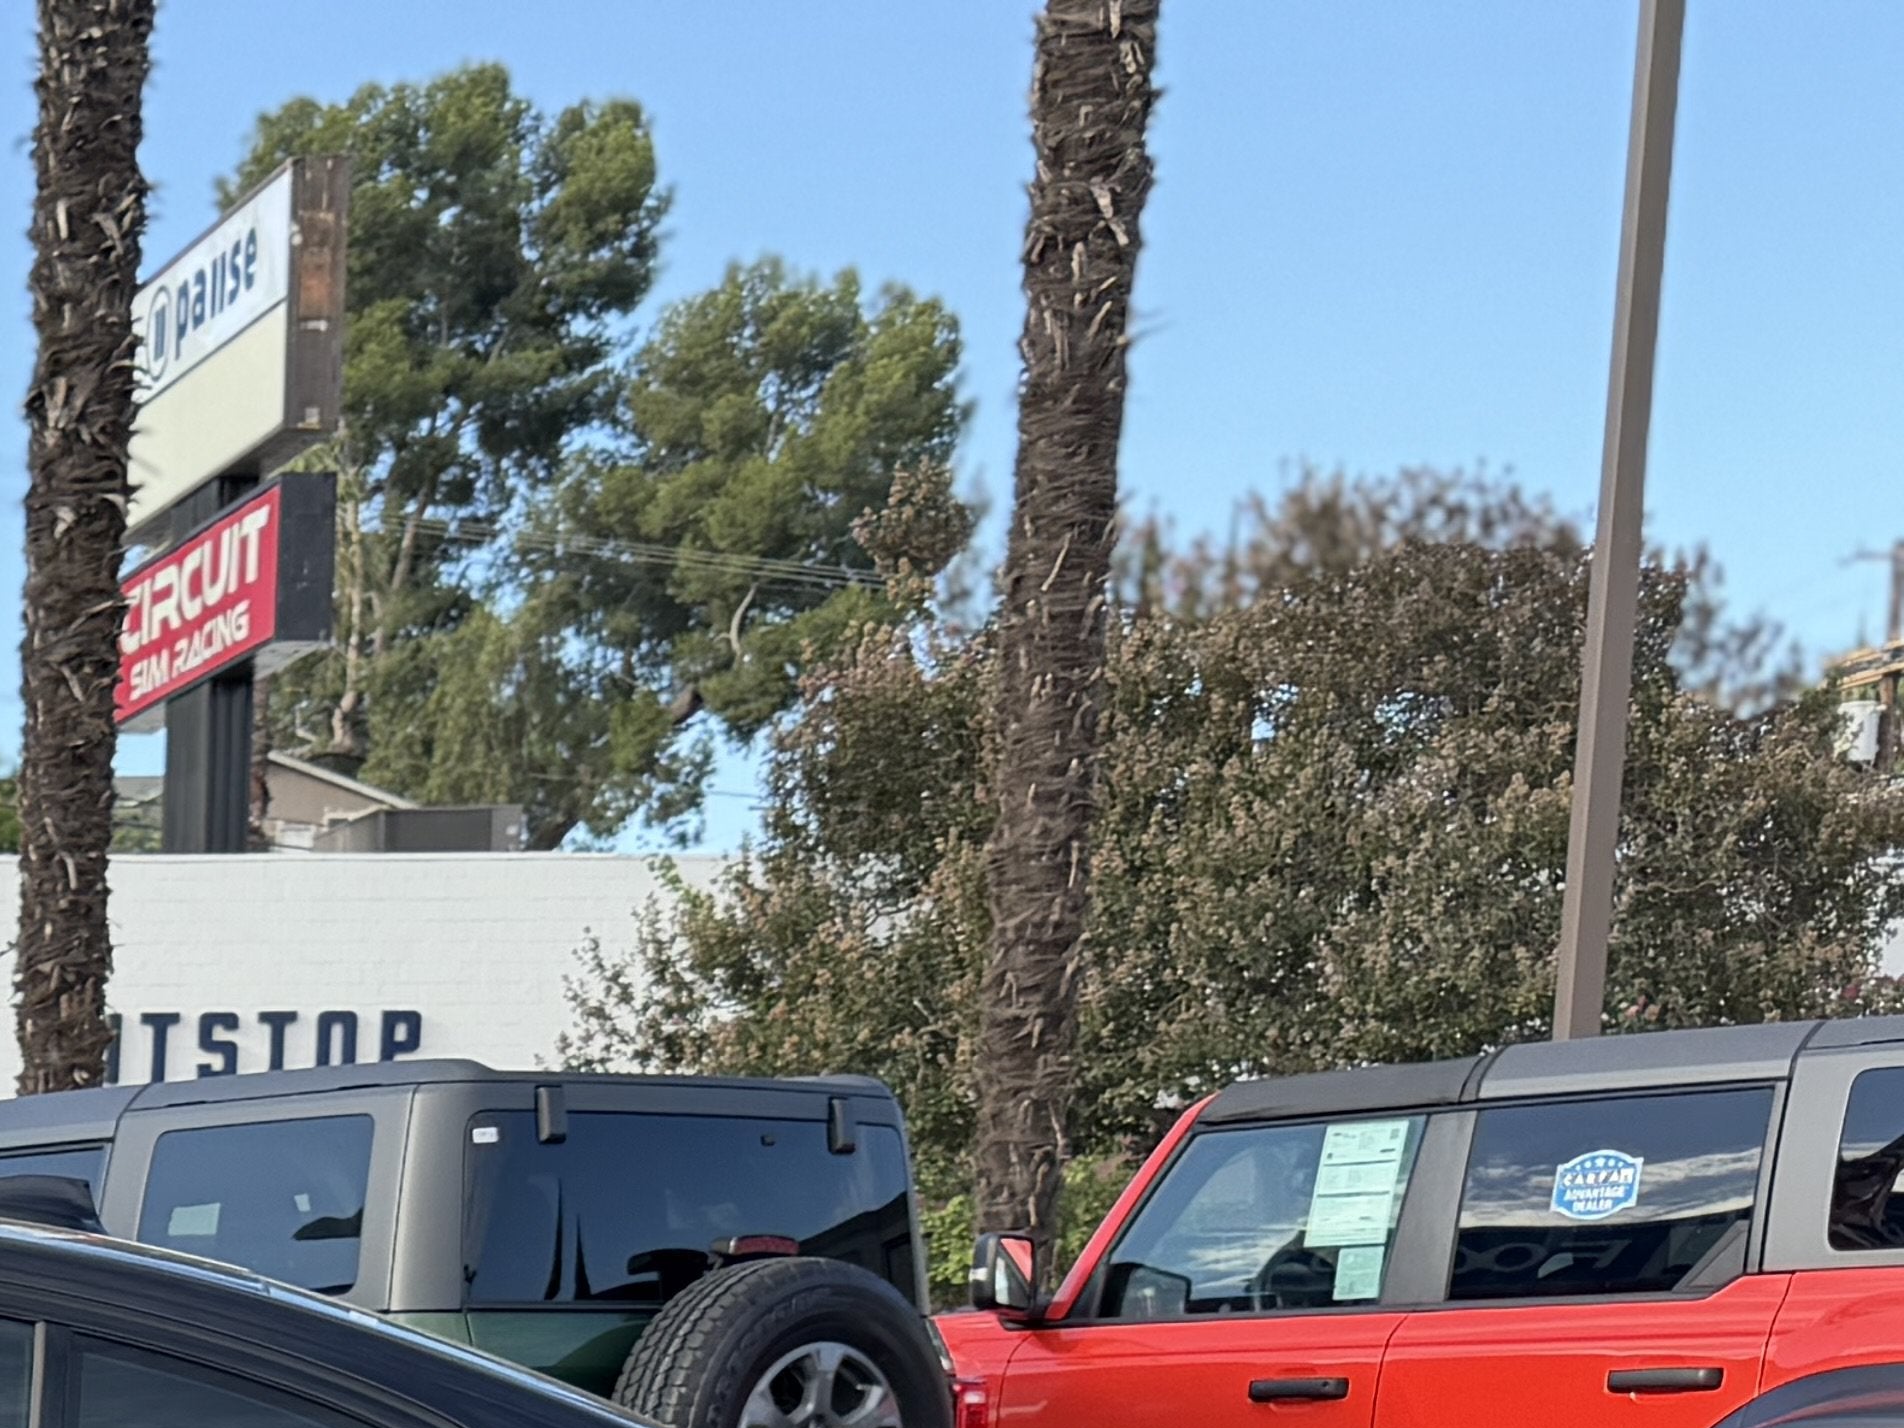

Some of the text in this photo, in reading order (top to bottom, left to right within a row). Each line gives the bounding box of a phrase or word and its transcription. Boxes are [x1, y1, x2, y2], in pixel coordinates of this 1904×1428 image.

[121, 504, 270, 654] CIRCUIT
[129, 599, 250, 701] SIM RACING
[103, 1010, 422, 1084] ITSTOP
